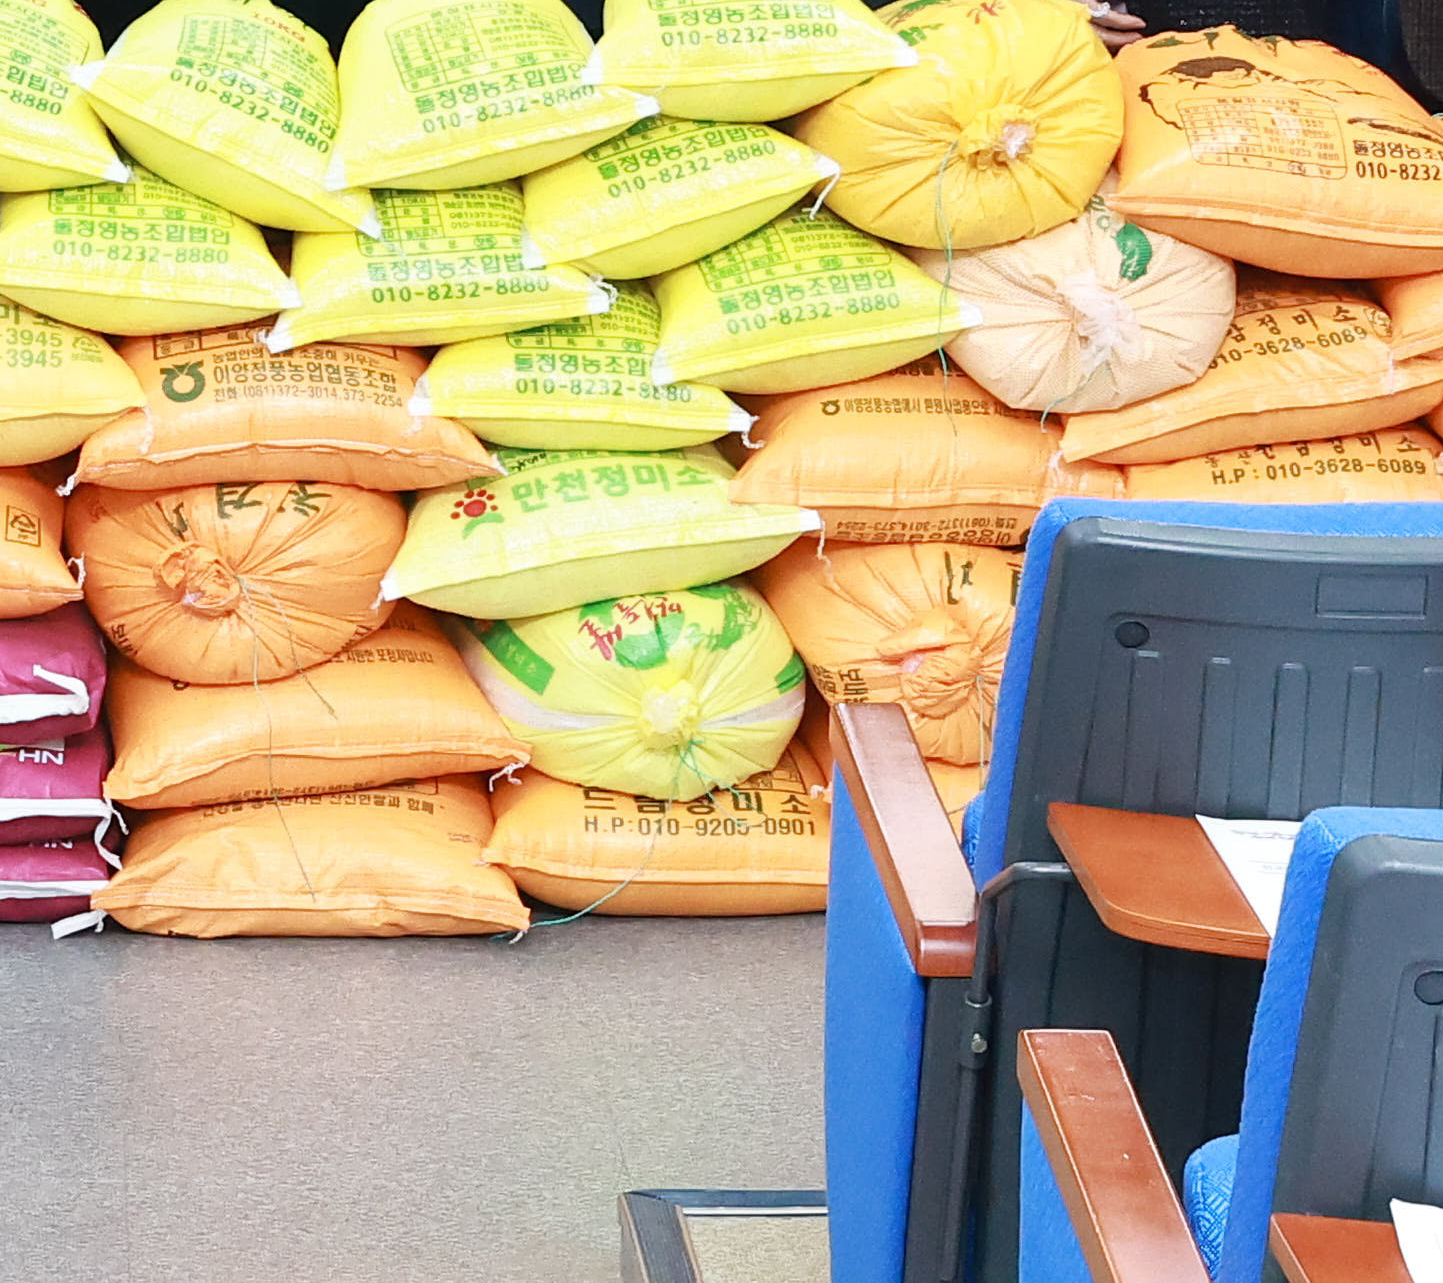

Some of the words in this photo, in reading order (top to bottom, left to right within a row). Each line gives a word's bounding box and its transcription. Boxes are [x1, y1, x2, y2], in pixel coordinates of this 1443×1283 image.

[661, 23, 838, 47] 010-8232-8880
[169, 67, 331, 155] 010-8232-8880
[607, 139, 777, 198] 010-8232-8880
[53, 238, 230, 265] 010-8232-8880
[371, 274, 551, 304] 010-8232-8880
[726, 295, 900, 336] 010-8232-8880
[515, 378, 692, 404] 010-8232-8880
[1266, 458, 1427, 480] 010-3628-6089
[511, 460, 713, 512] 만천정미소
[17, 748, 65, 766] NH
